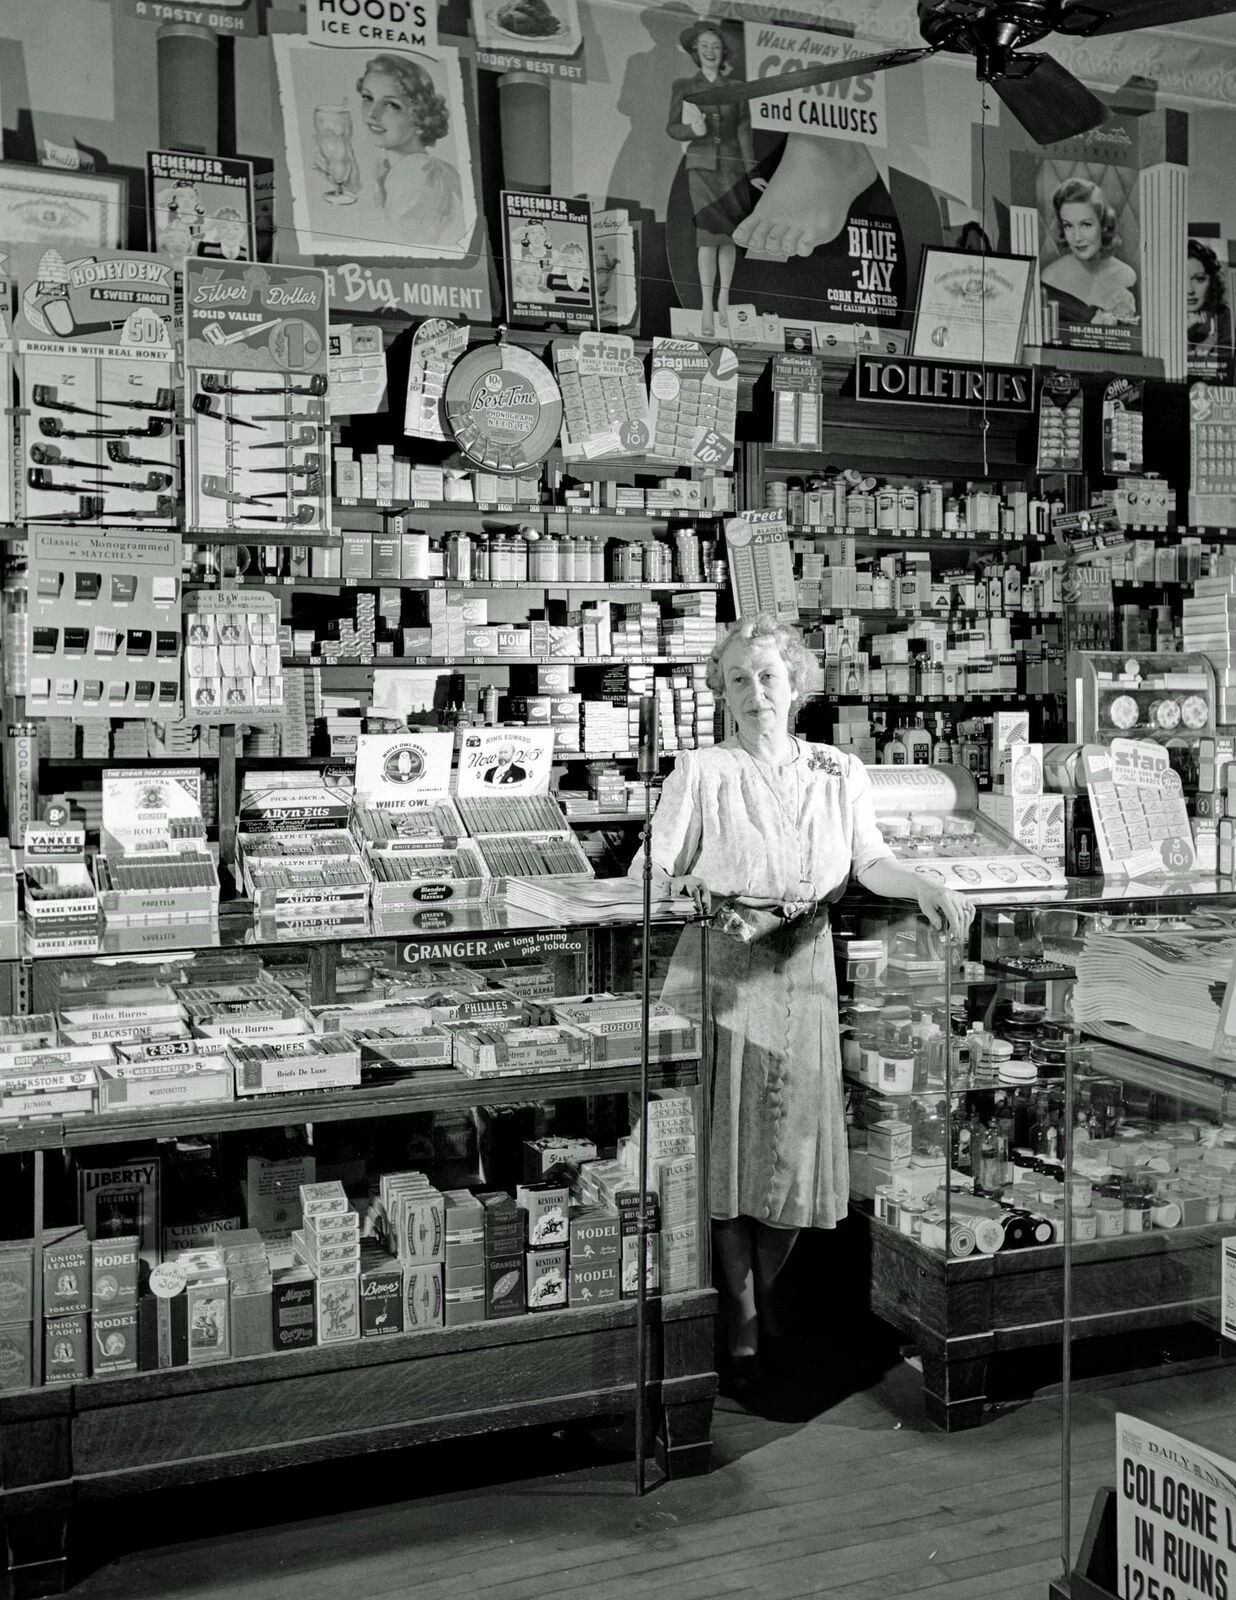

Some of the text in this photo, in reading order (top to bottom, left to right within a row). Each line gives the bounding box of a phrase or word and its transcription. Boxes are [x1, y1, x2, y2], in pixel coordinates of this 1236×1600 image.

[136, 3, 244, 29] A TASTY DISH
[319, 0, 426, 28] HOOD'S
[322, 20, 426, 46] ICE CREAM
[475, 52, 582, 77] TODAY'S BEST BET
[760, 98, 877, 135] and CALLUSES
[152, 154, 223, 174] REMEMBER
[153, 166, 168, 177] The
[507, 195, 568, 213] REMEMBER
[508, 206, 522, 216] The
[523, 208, 550, 220] Children
[848, 226, 897, 262] BLUE
[73, 261, 162, 285] HONEY DEW
[193, 280, 248, 304] Silver
[266, 286, 318, 306] Dollar
[338, 262, 401, 312] Big
[404, 281, 483, 309] MOMENT
[102, 291, 133, 302] SWEET
[134, 293, 168, 305] SMOKE
[827, 288, 898, 308] CORN PLASTERS
[192, 309, 263, 323] SOLID VALUE
[866, 307, 897, 317] PLASTERS
[27, 343, 168, 360] BROKEN IN WITH REAL HONEY
[653, 355, 709, 371] stag BLADES
[864, 362, 1027, 403] TOILETRIES
[473, 385, 537, 411] Best Tone
[486, 409, 534, 424] PHONOGRAPH
[488, 419, 531, 433] NEEDLES
[705, 433, 717, 446] 5
[696, 446, 721, 464] 10¢
[741, 508, 785, 524] Treet
[756, 526, 783, 535] BLADES
[41, 535, 170, 552] Classic Monogrammed
[81, 550, 134, 559] MATCHES
[9, 727, 36, 737] FRESH
[486, 734, 532, 744] KING EDWARD
[381, 744, 398, 759] WHITE
[468, 751, 498, 768] Now
[375, 799, 430, 809] WHITE OWL
[261, 807, 330, 820] Allyn-Etts
[31, 836, 81, 845] YANKEE
[420, 886, 446, 894] Blended
[36, 904, 96, 915] YANKEE YANKEE
[403, 931, 567, 963] GRANGER long lasting
[521, 941, 582, 956] pipe tobacco
[464, 1000, 508, 1013] PHILLIES
[91, 1027, 152, 1040] BLACKSTONE
[245, 1025, 274, 1035] Burns
[116, 1062, 203, 1077] 5 5
[298, 1067, 308, 1076] De
[310, 1065, 327, 1075] Luxe
[23, 1099, 52, 1110] JUNIOR
[86, 1166, 155, 1192] LIBERTY
[172, 1220, 232, 1237] CHEWING
[576, 1226, 619, 1241] MODEL
[48, 1260, 86, 1271] LEADER
[50, 1253, 138, 1268] UNION MODEL
[491, 1260, 521, 1270] GRANGER
[575, 1268, 616, 1284] MODEL
[49, 1303, 87, 1313] TOBACCO
[46, 1317, 138, 1331] UNION MODEL
[1148, 1441, 1190, 1468] DAILY
[1123, 1457, 1218, 1544] COLOGNE
[1135, 1515, 1229, 1600] IN RUINS
